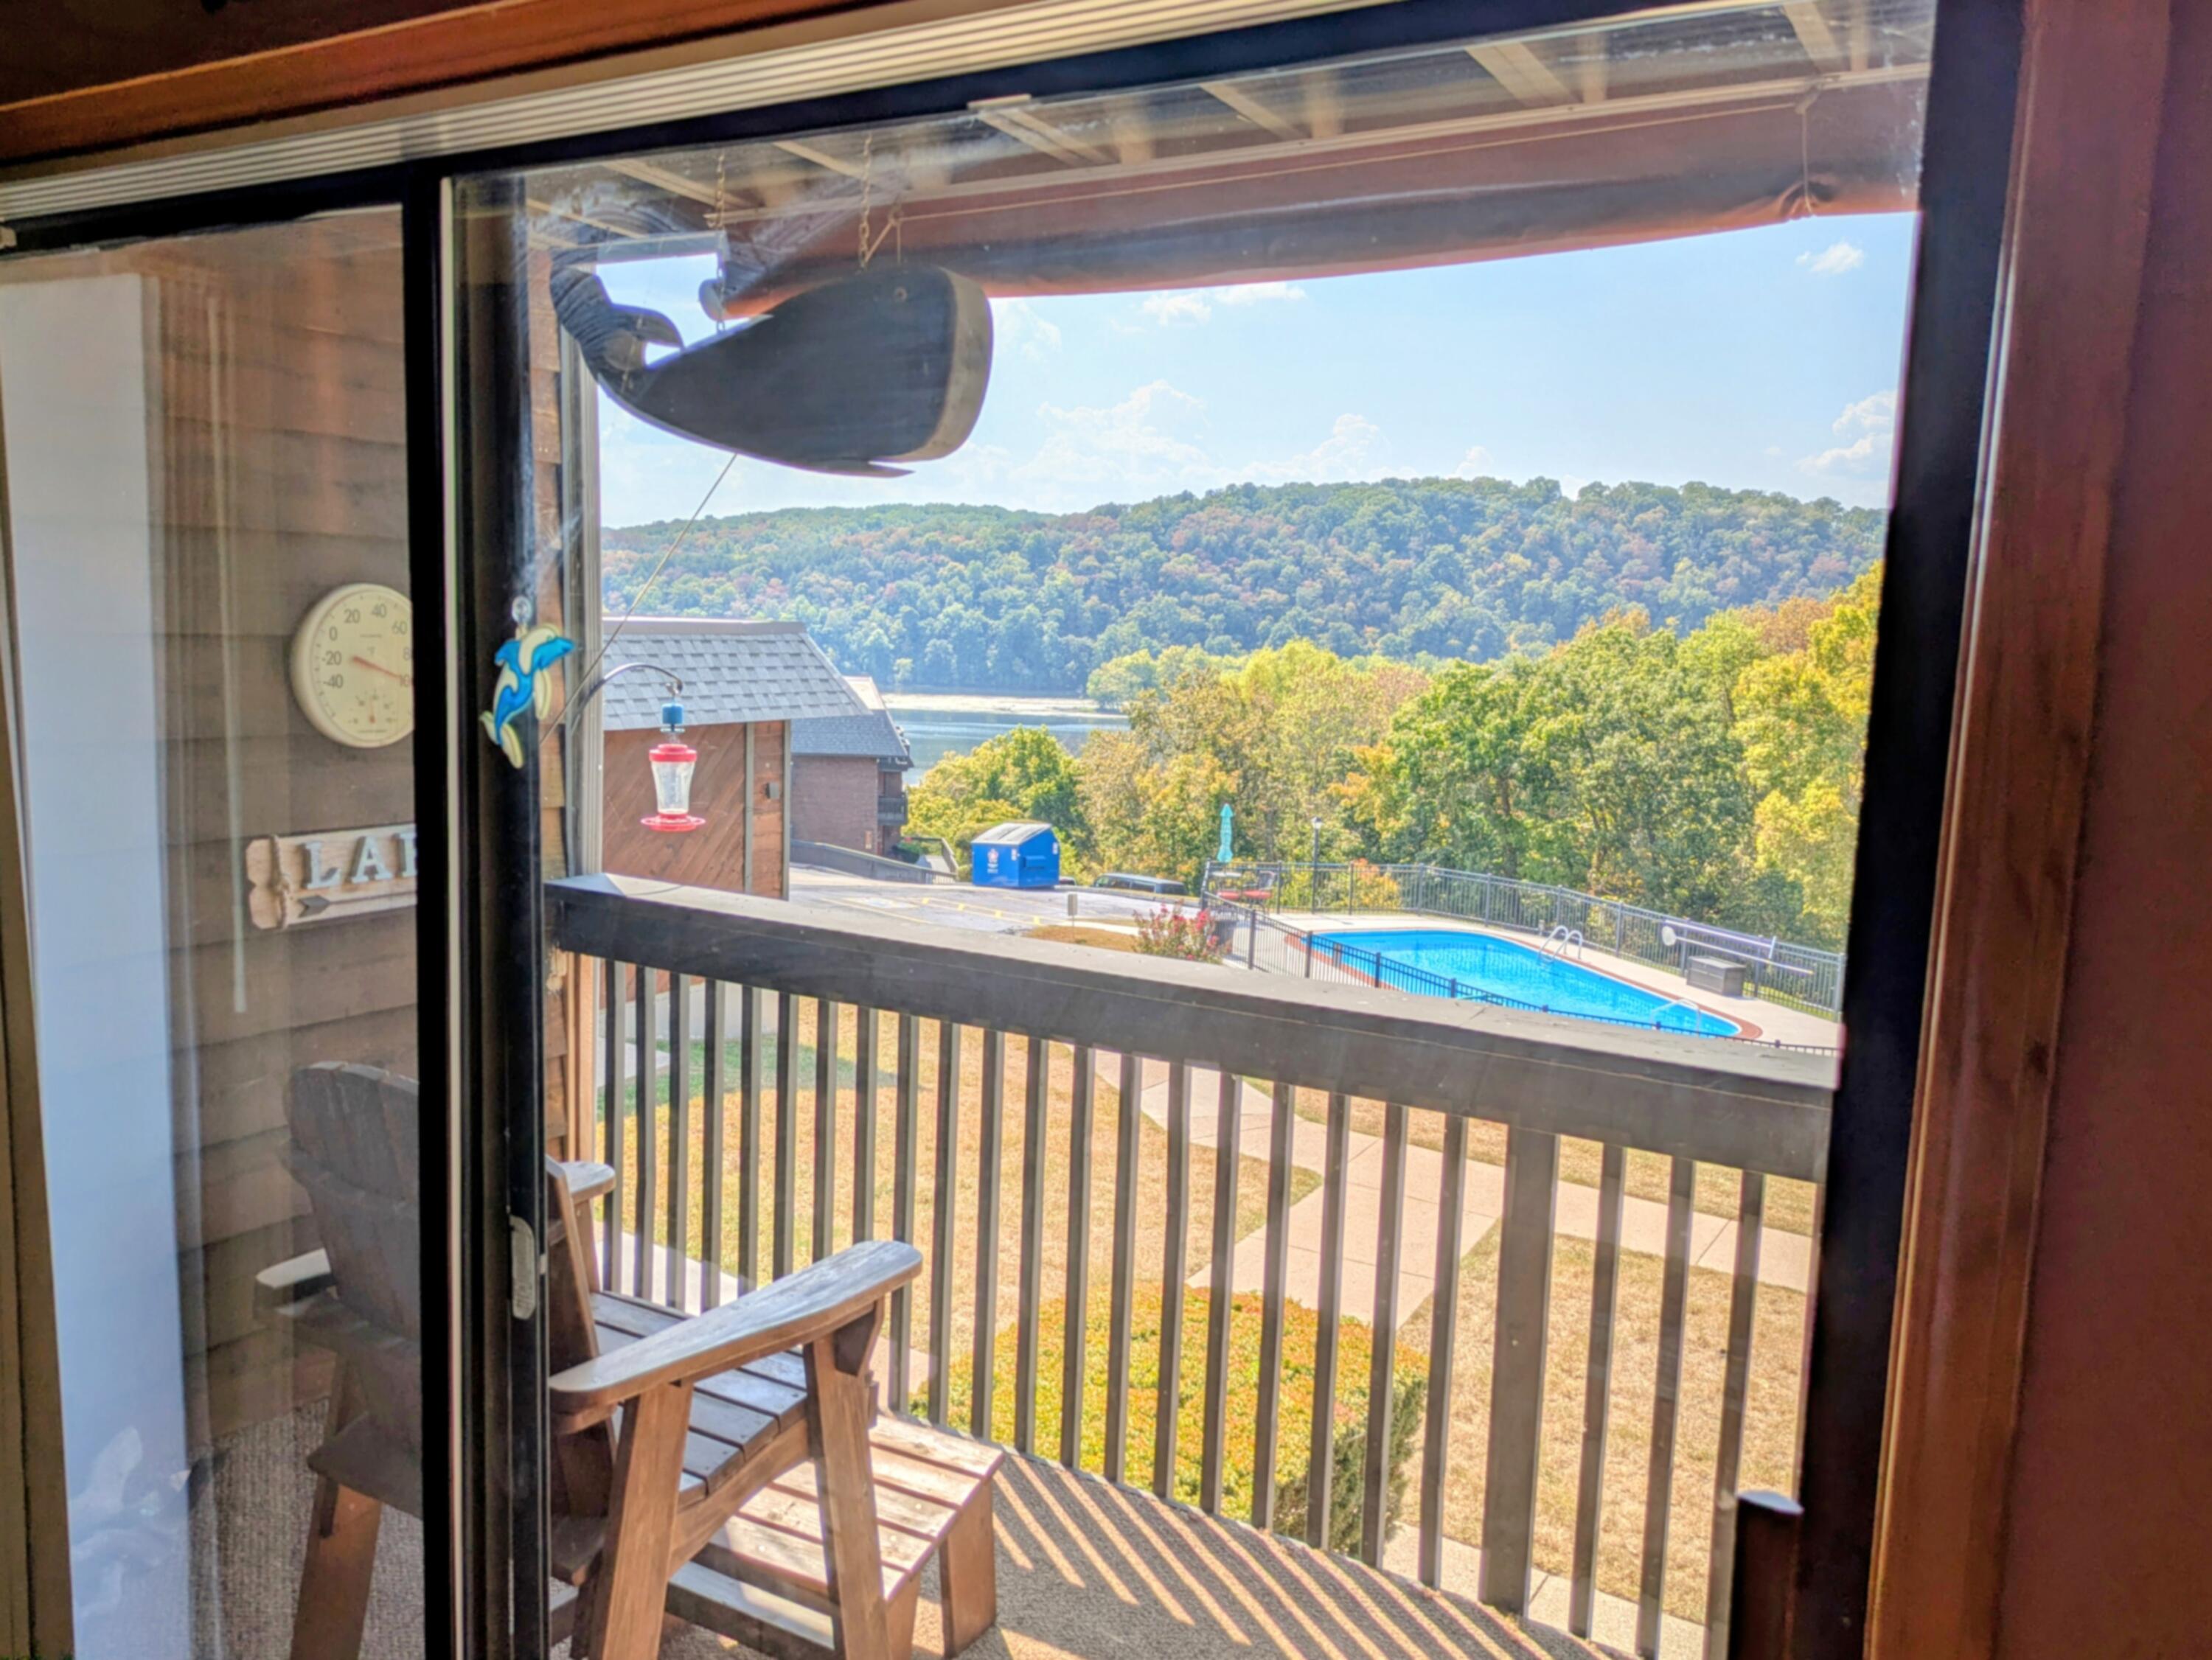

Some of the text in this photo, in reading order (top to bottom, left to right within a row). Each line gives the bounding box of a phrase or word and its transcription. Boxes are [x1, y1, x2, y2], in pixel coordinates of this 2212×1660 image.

[344, 608, 361, 624] 20
[371, 603, 387, 618] 40
[329, 626, 338, 641] 0
[391, 621, 408, 635] 60
[403, 646, 411, 661] 8
